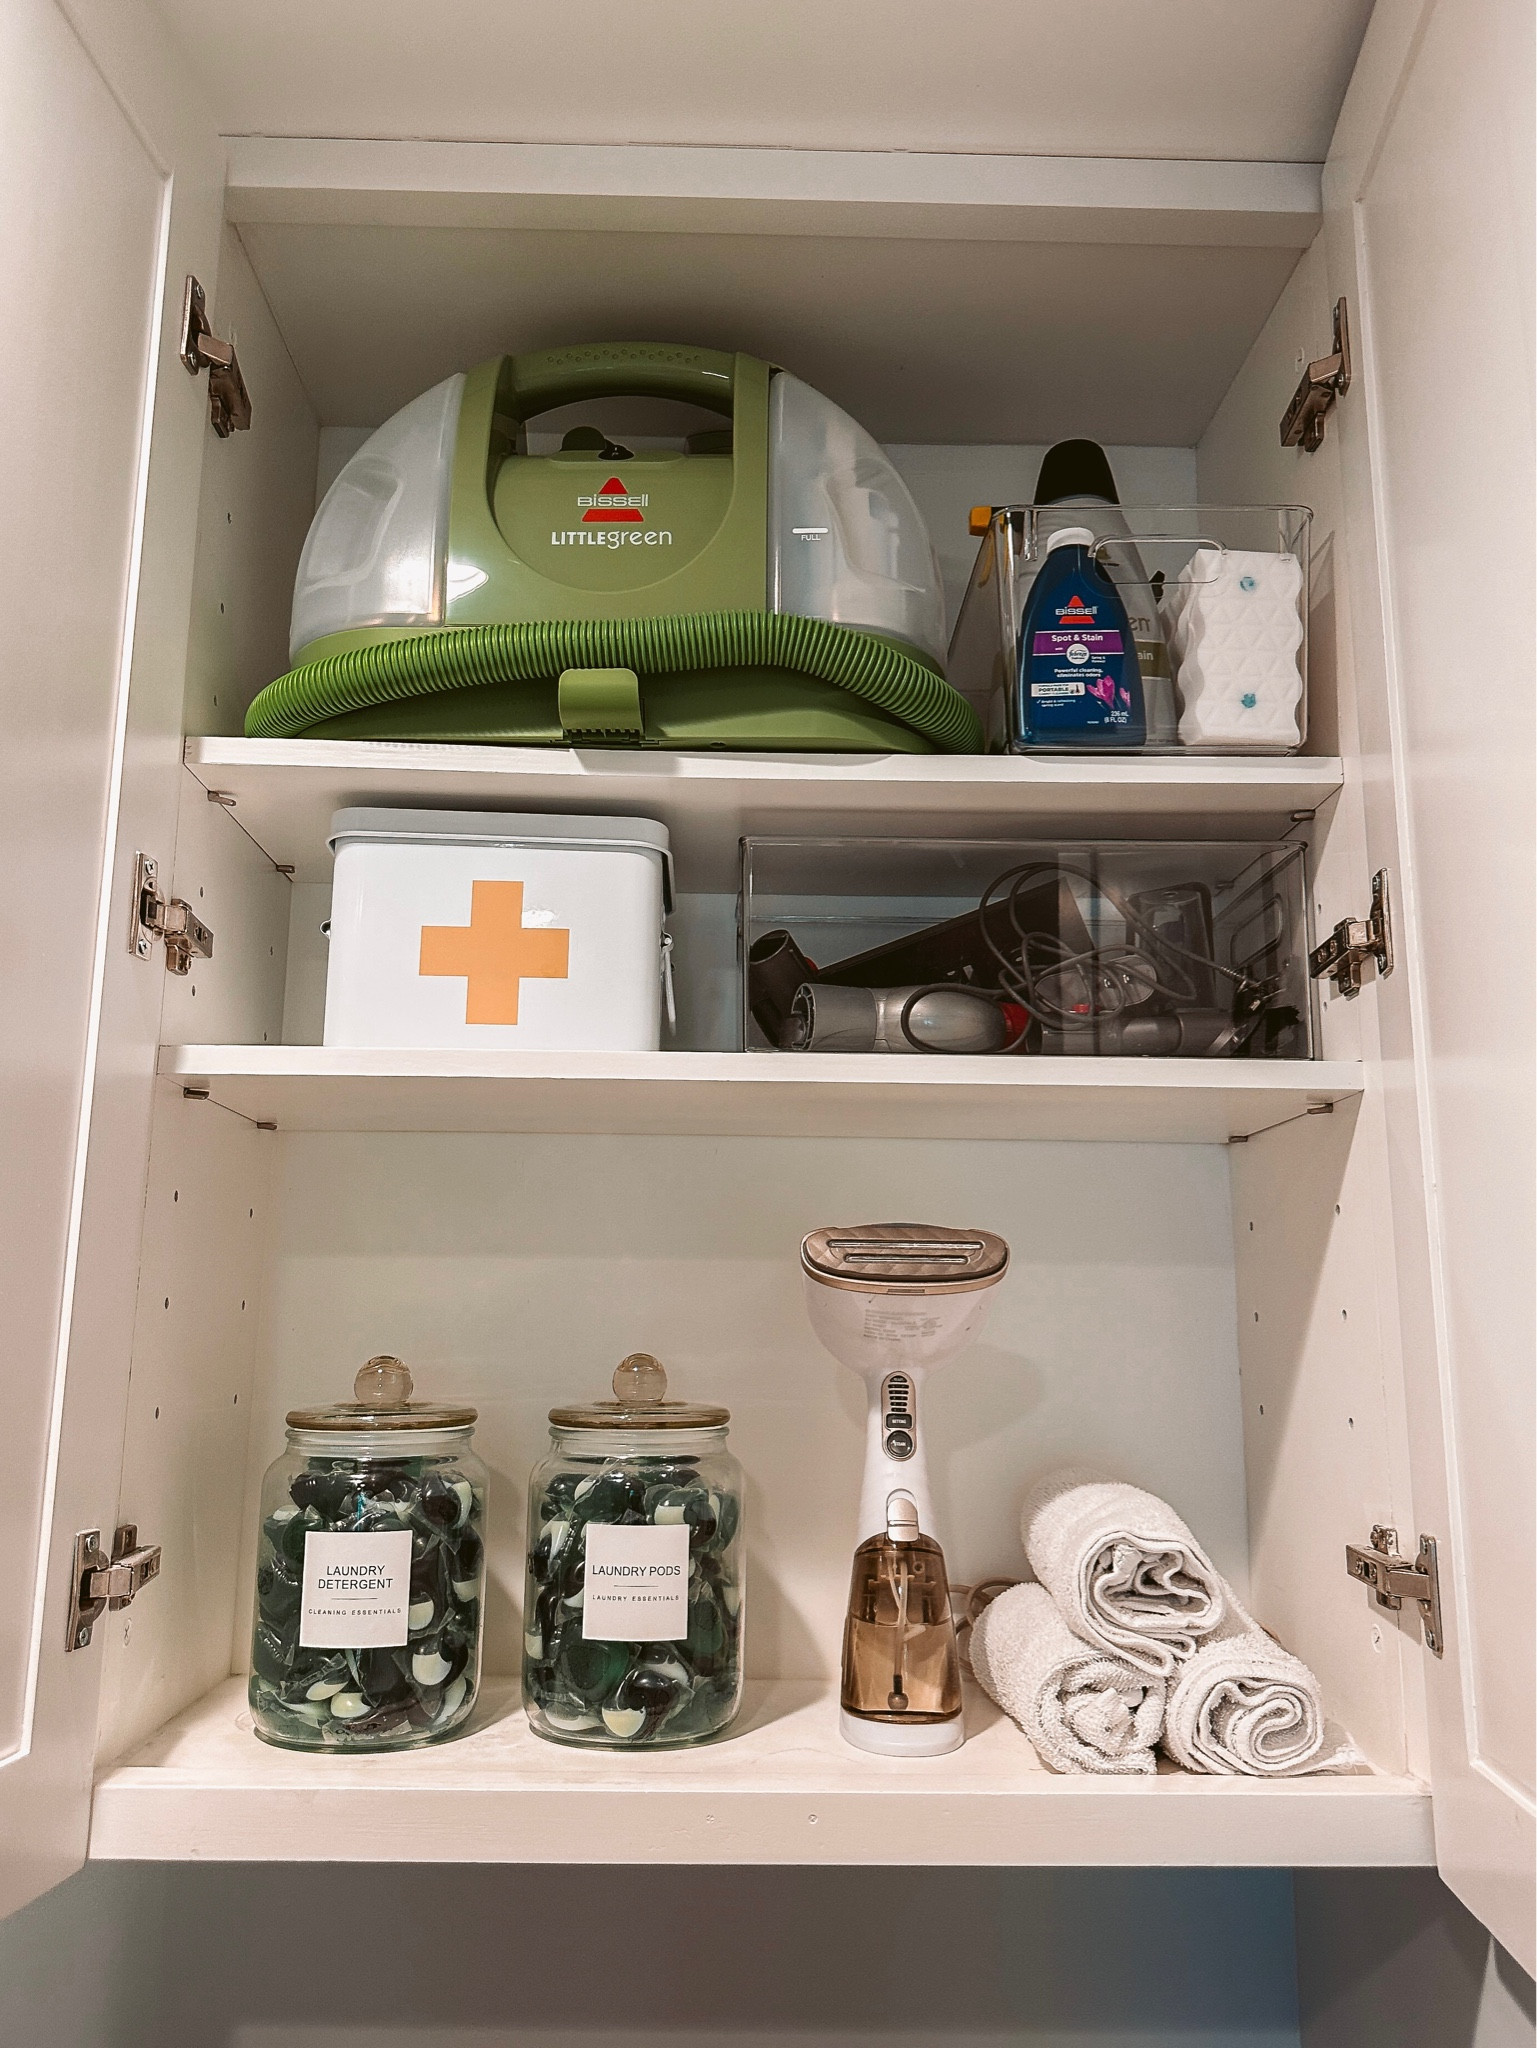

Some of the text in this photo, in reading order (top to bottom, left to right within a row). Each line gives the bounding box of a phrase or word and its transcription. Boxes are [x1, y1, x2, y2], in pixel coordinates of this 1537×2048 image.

[1051, 634, 1072, 643] Spot
[1081, 633, 1104, 642] Stain
[326, 1565, 386, 1576] LAUNDRY
[592, 1564, 681, 1577] LAUNDRY PODS
[318, 1578, 394, 1590] DETERGENT
[632, 1594, 680, 1602] ESSENTIALS
[308, 1607, 402, 1616] CLEANING ESSENTIALS
